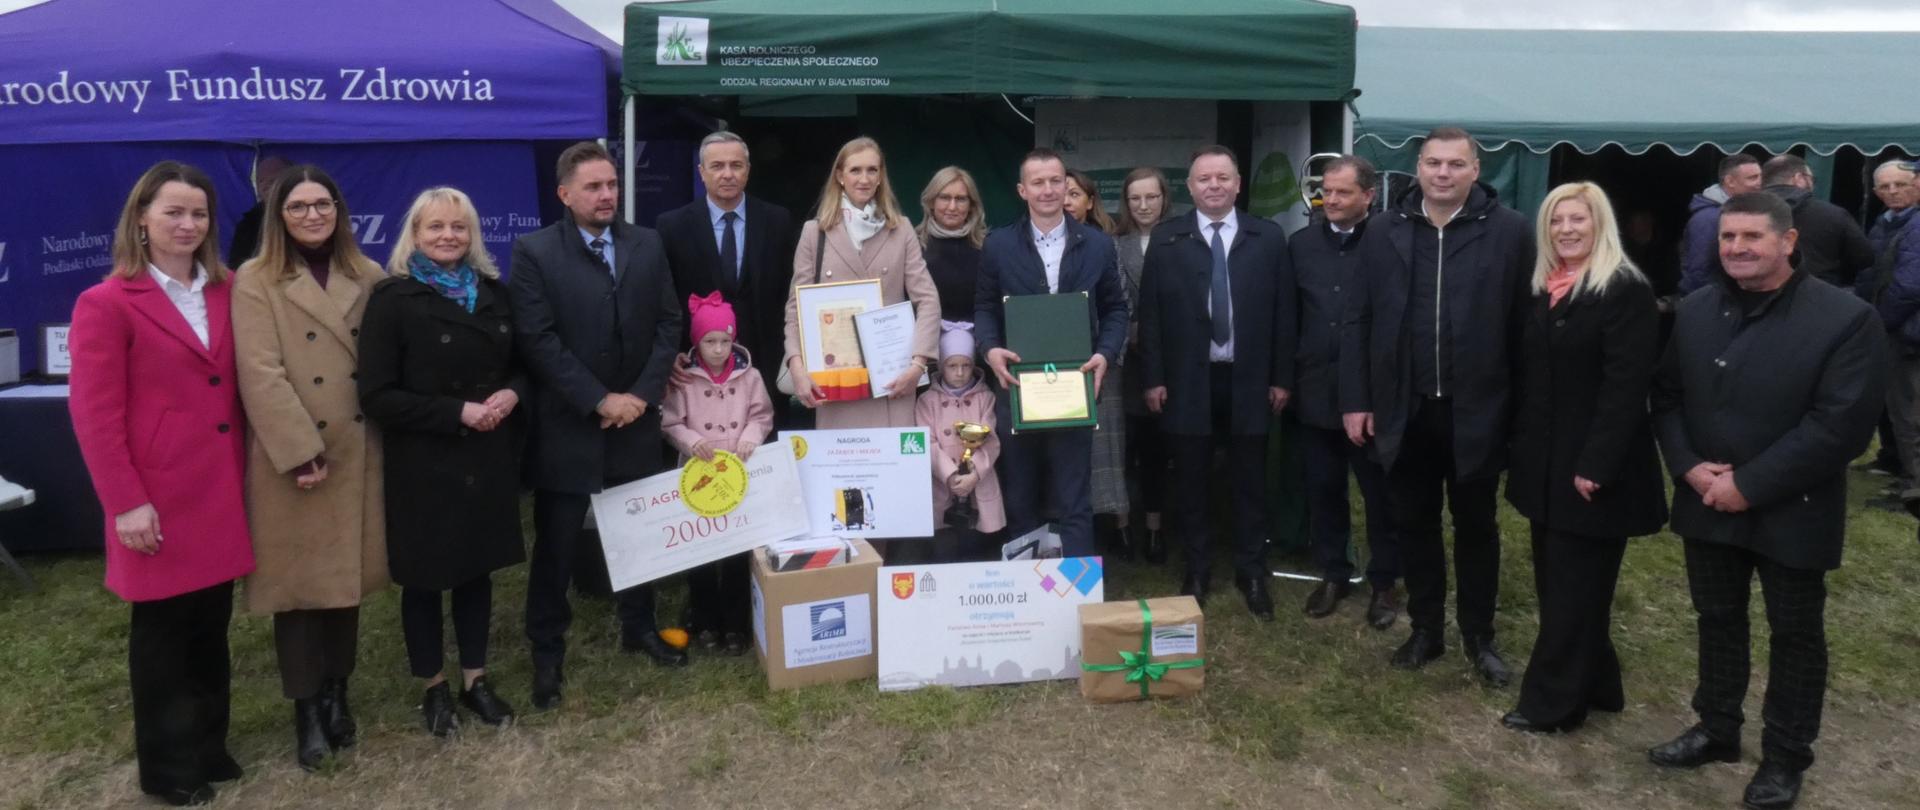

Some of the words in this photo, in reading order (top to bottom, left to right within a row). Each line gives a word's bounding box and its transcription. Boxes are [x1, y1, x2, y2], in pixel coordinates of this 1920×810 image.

[720, 46, 747, 54] KASA
[749, 45, 816, 54] ROLNICZEGO
[720, 57, 801, 66] UBEZPIECZENIA
[803, 56, 879, 66] SPOŁECZNEGO
[0, 70, 152, 113] rodowy
[165, 66, 327, 102] Fundusz
[340, 67, 495, 101] Zdrowia
[720, 78, 758, 86] ODDZIAŁ
[760, 77, 816, 86] REGIONALNY
[829, 78, 890, 86] BIAŁYMSTOKU
[348, 214, 387, 245] FZ
[42, 231, 111, 254] Narodowy
[651, 489, 681, 507] AGR
[662, 514, 729, 549] 2000
[1016, 592, 1028, 603] zł
